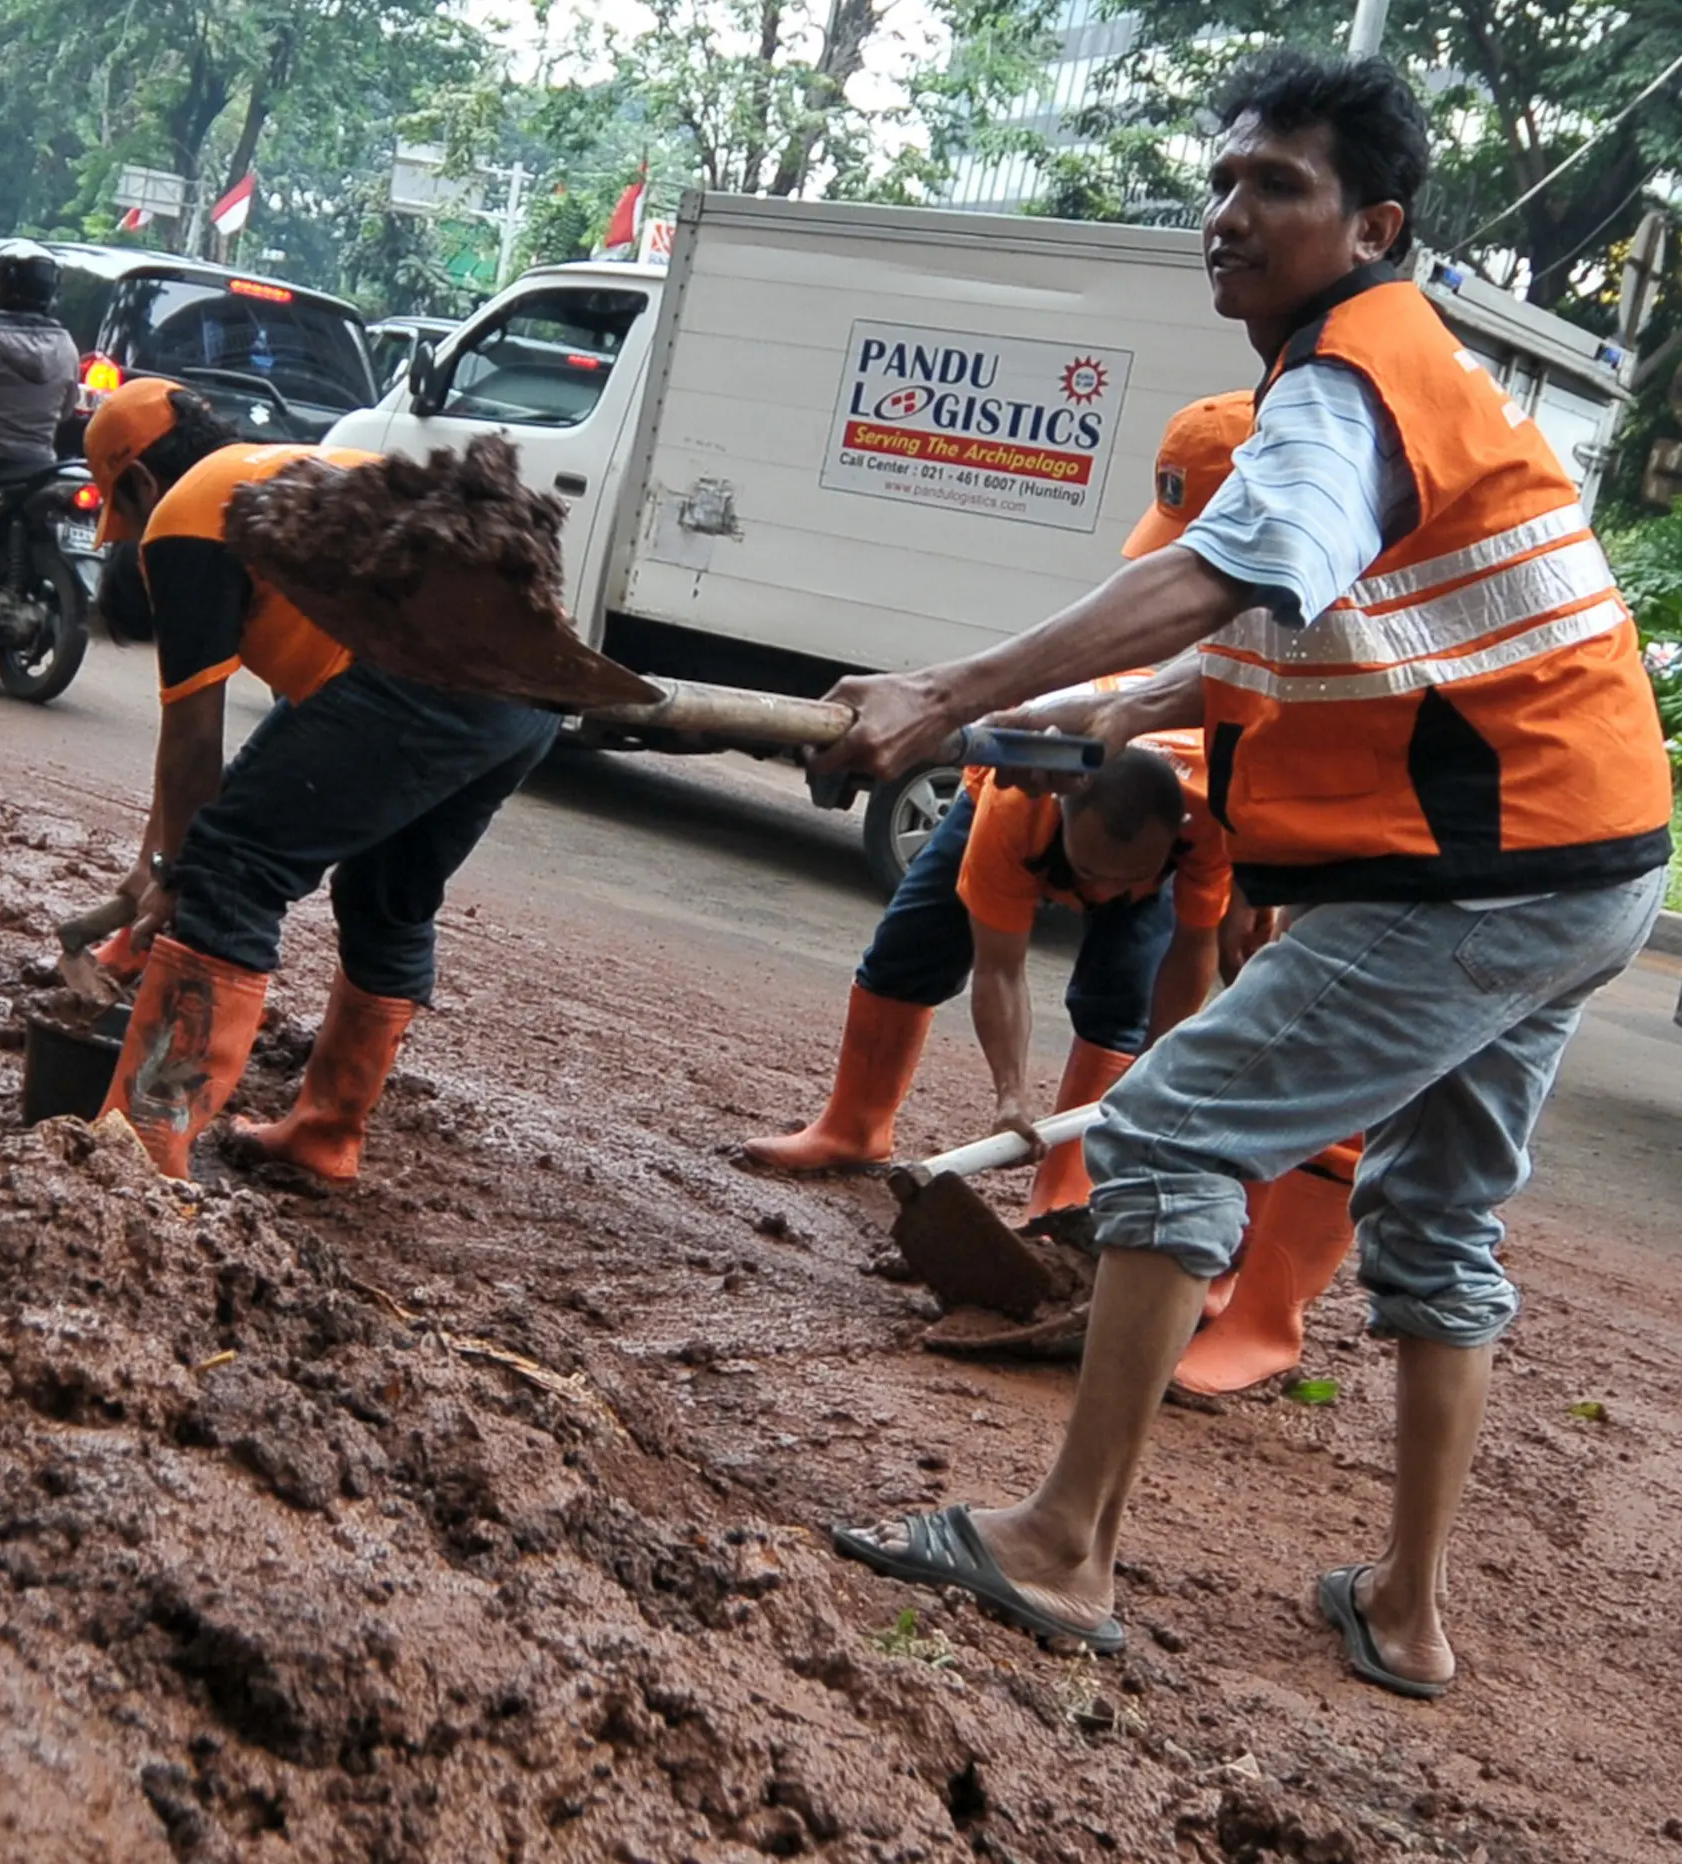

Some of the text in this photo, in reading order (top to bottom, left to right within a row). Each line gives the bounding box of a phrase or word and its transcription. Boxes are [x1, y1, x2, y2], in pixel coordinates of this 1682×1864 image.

[858, 338, 999, 389] PANDU
[850, 381, 1103, 450] LOGISTICS
[839, 452, 864, 467] Call
[867, 457, 910, 475] Center
[921, 465, 943, 480] 021
[983, 474, 1016, 491] 6007
[1019, 480, 1086, 507] (Hunting)
[853, 426, 1080, 480] Serving The Archipelago
[884, 480, 1027, 512] www.pandulogistics.com
